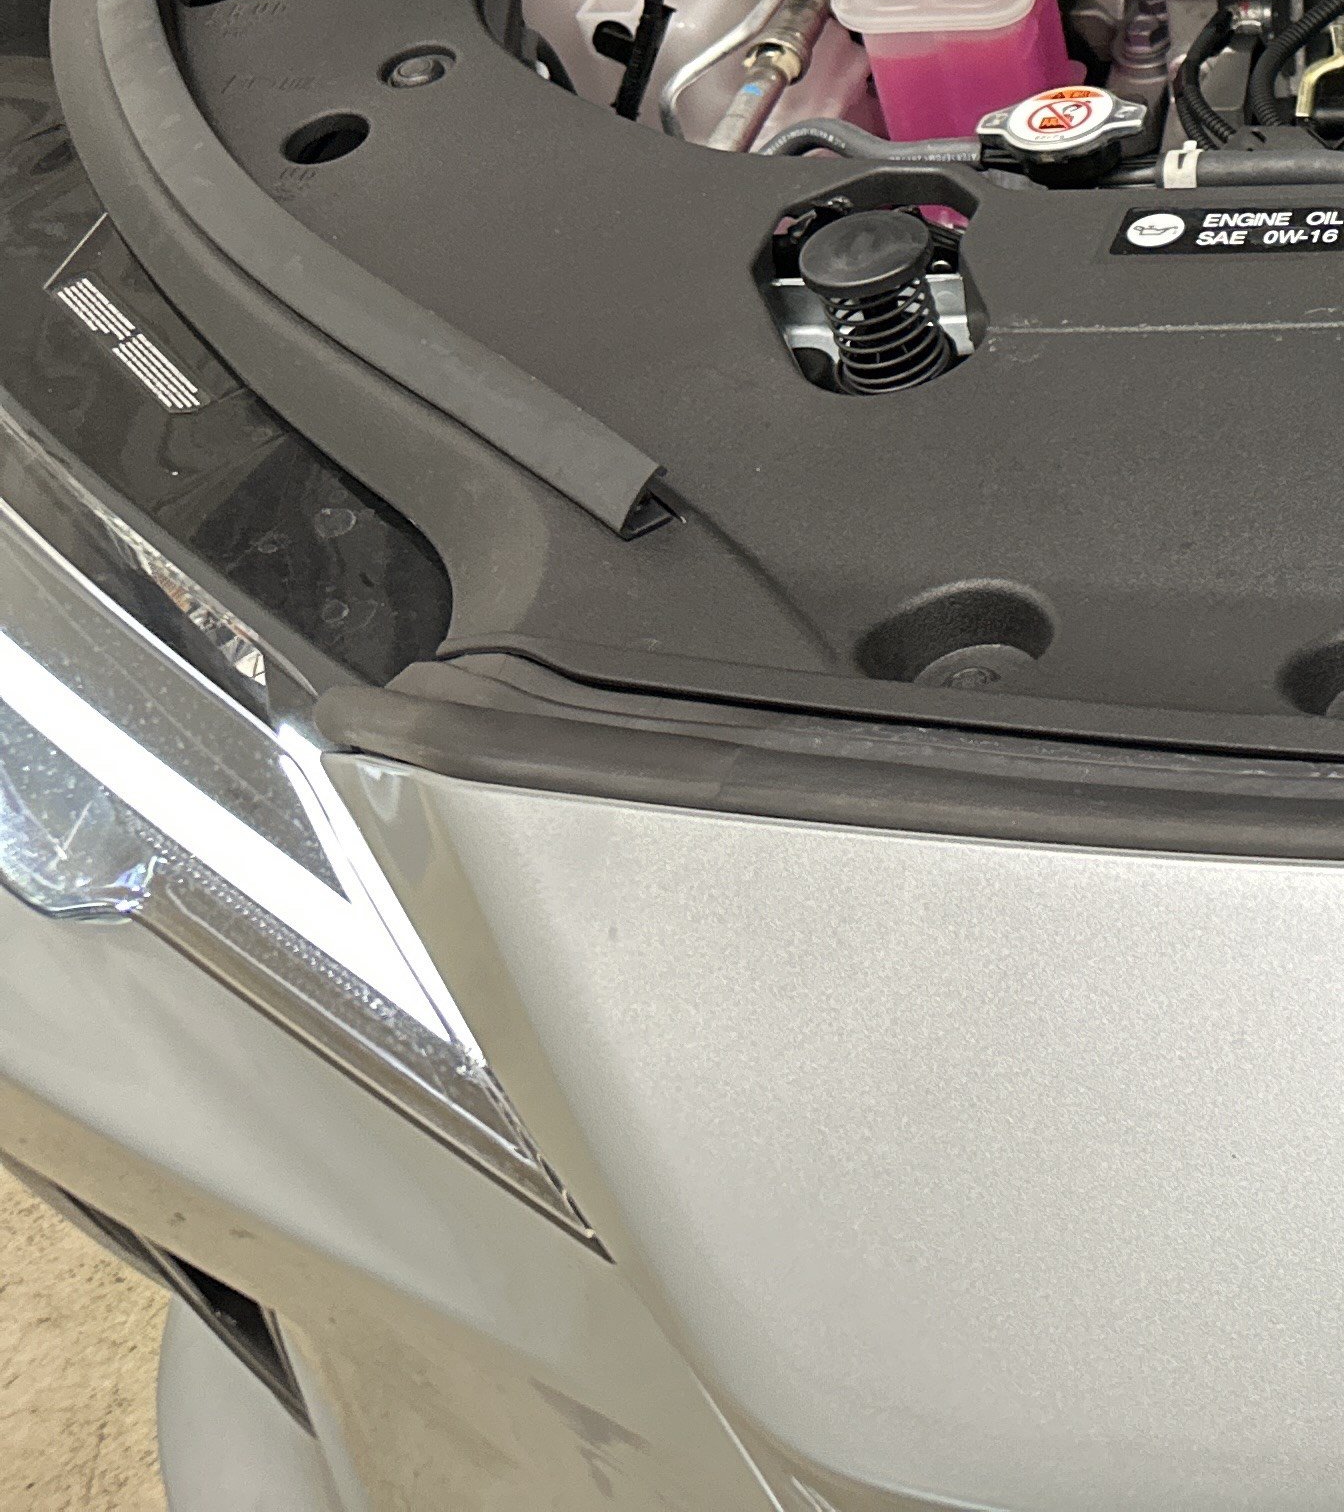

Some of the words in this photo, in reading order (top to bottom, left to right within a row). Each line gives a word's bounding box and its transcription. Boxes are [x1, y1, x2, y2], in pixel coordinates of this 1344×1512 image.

[1202, 212, 1293, 228] ENGINE
[1305, 211, 1344, 226] OIL
[1195, 230, 1248, 247] SAE
[1262, 229, 1339, 245] 0W-16
